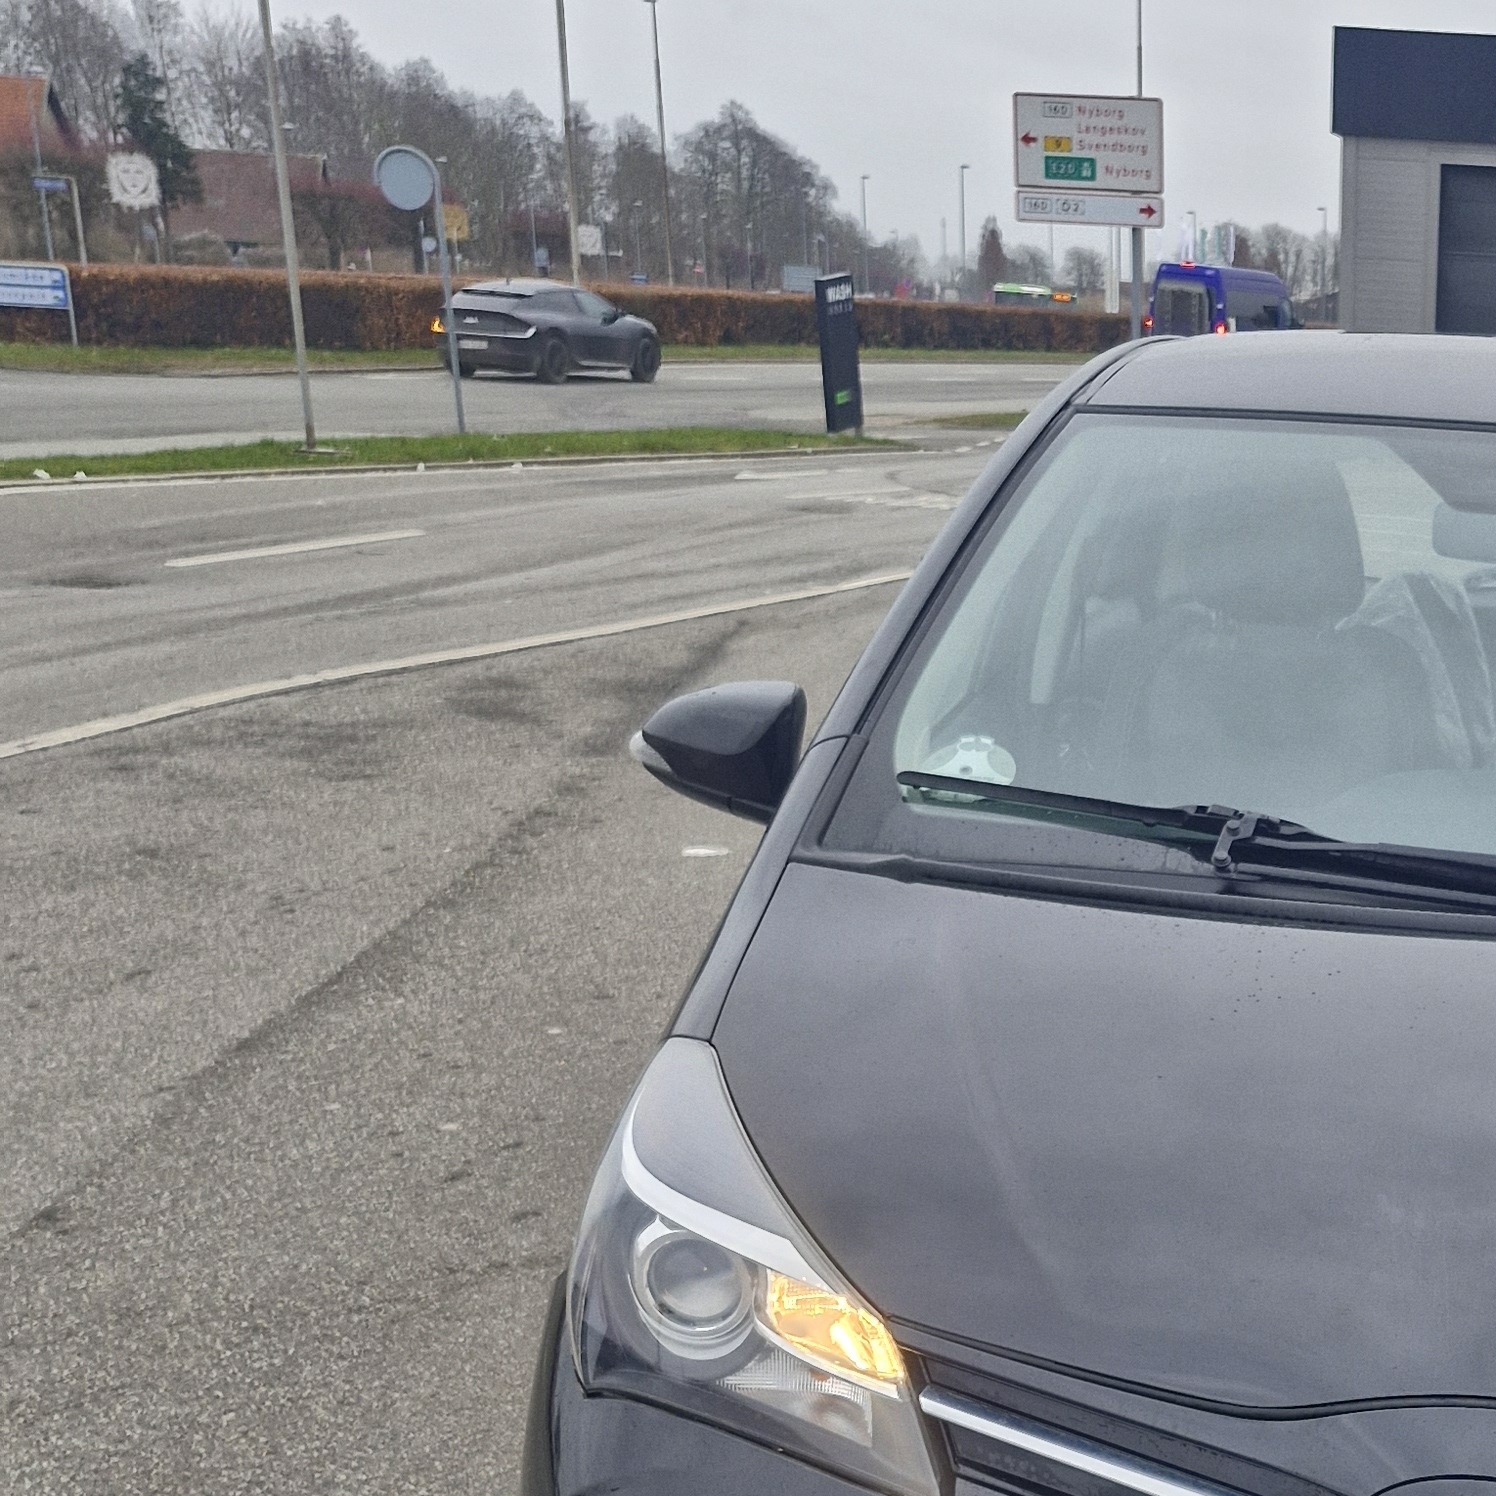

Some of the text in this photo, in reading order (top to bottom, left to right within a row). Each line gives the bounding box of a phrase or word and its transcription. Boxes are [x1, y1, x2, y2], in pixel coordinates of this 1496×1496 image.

[1077, 105, 1125, 120] Nyborg
[1077, 139, 1148, 156] Svendborg
[1104, 165, 1152, 180] Nyborg
